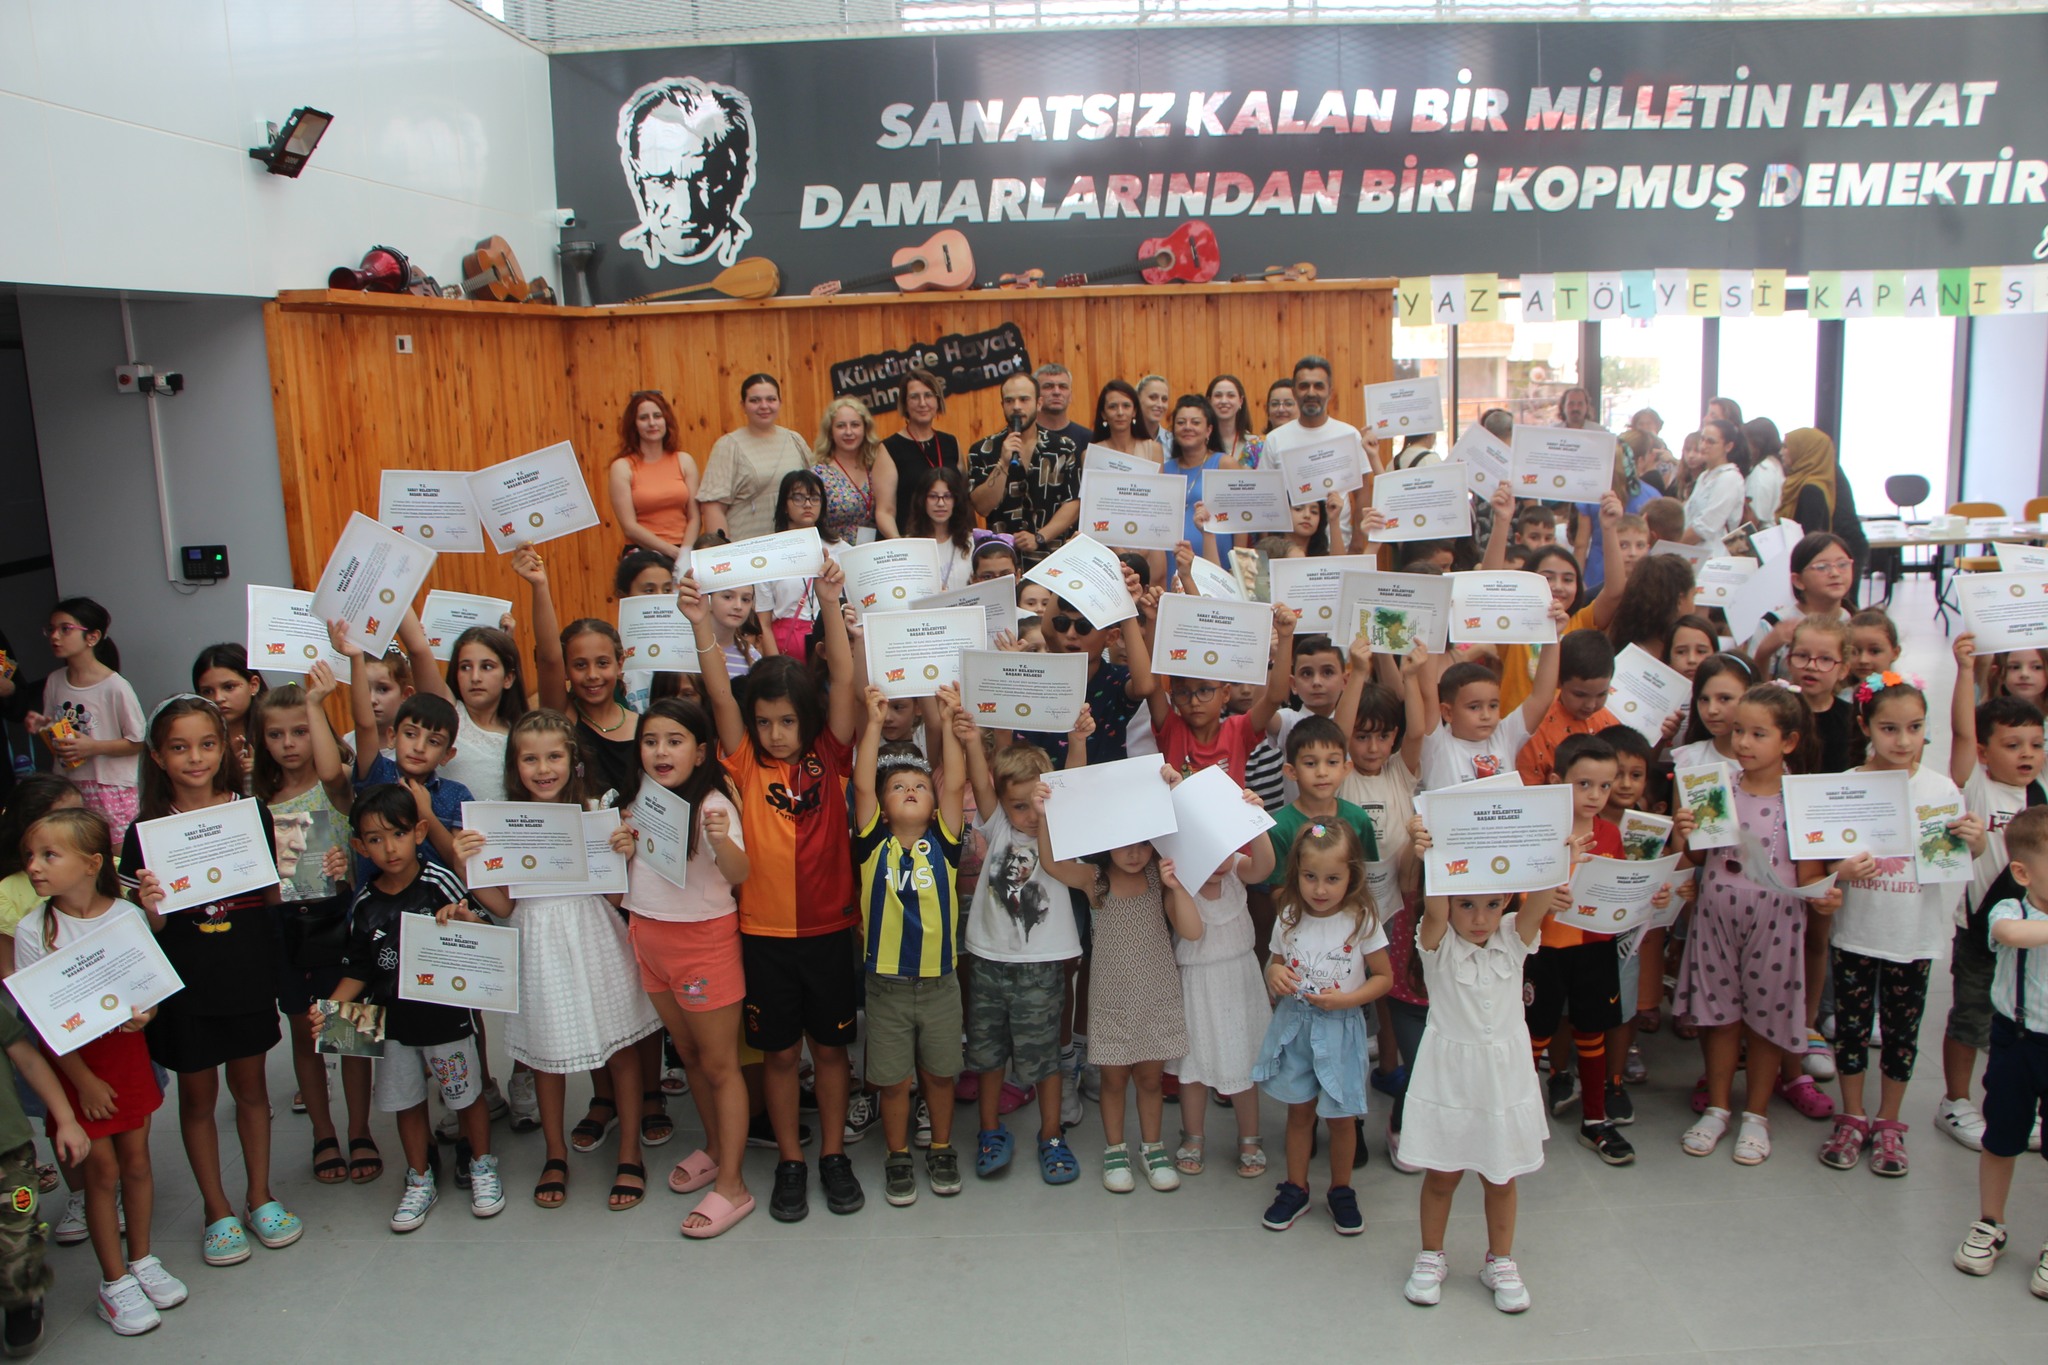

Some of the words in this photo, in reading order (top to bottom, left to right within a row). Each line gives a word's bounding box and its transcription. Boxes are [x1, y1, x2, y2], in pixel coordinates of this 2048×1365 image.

[876, 92, 1176, 149] SANATSIZ
[1184, 88, 1397, 137] KALAN
[1410, 67, 1509, 133] BİR
[1524, 65, 1792, 131] MİLLETİN
[1803, 80, 1998, 128] HAYAT
[799, 169, 1343, 229] DAMARLARINDAN
[1357, 153, 1479, 214] BİRİ
[1492, 163, 1749, 222] KOPMUŞ
[1758, 146, 2048, 208] DEMEKTİR
[1402, 288, 1489, 317] YAZ
[1526, 279, 1772, 313] ATÖLYESİ
[1814, 280, 2048, 310] KAPANIŞ
[837, 349, 939, 390] Kültürde
[943, 329, 1016, 363] Hayat
[1851, 880, 1889, 891] HAPPY
